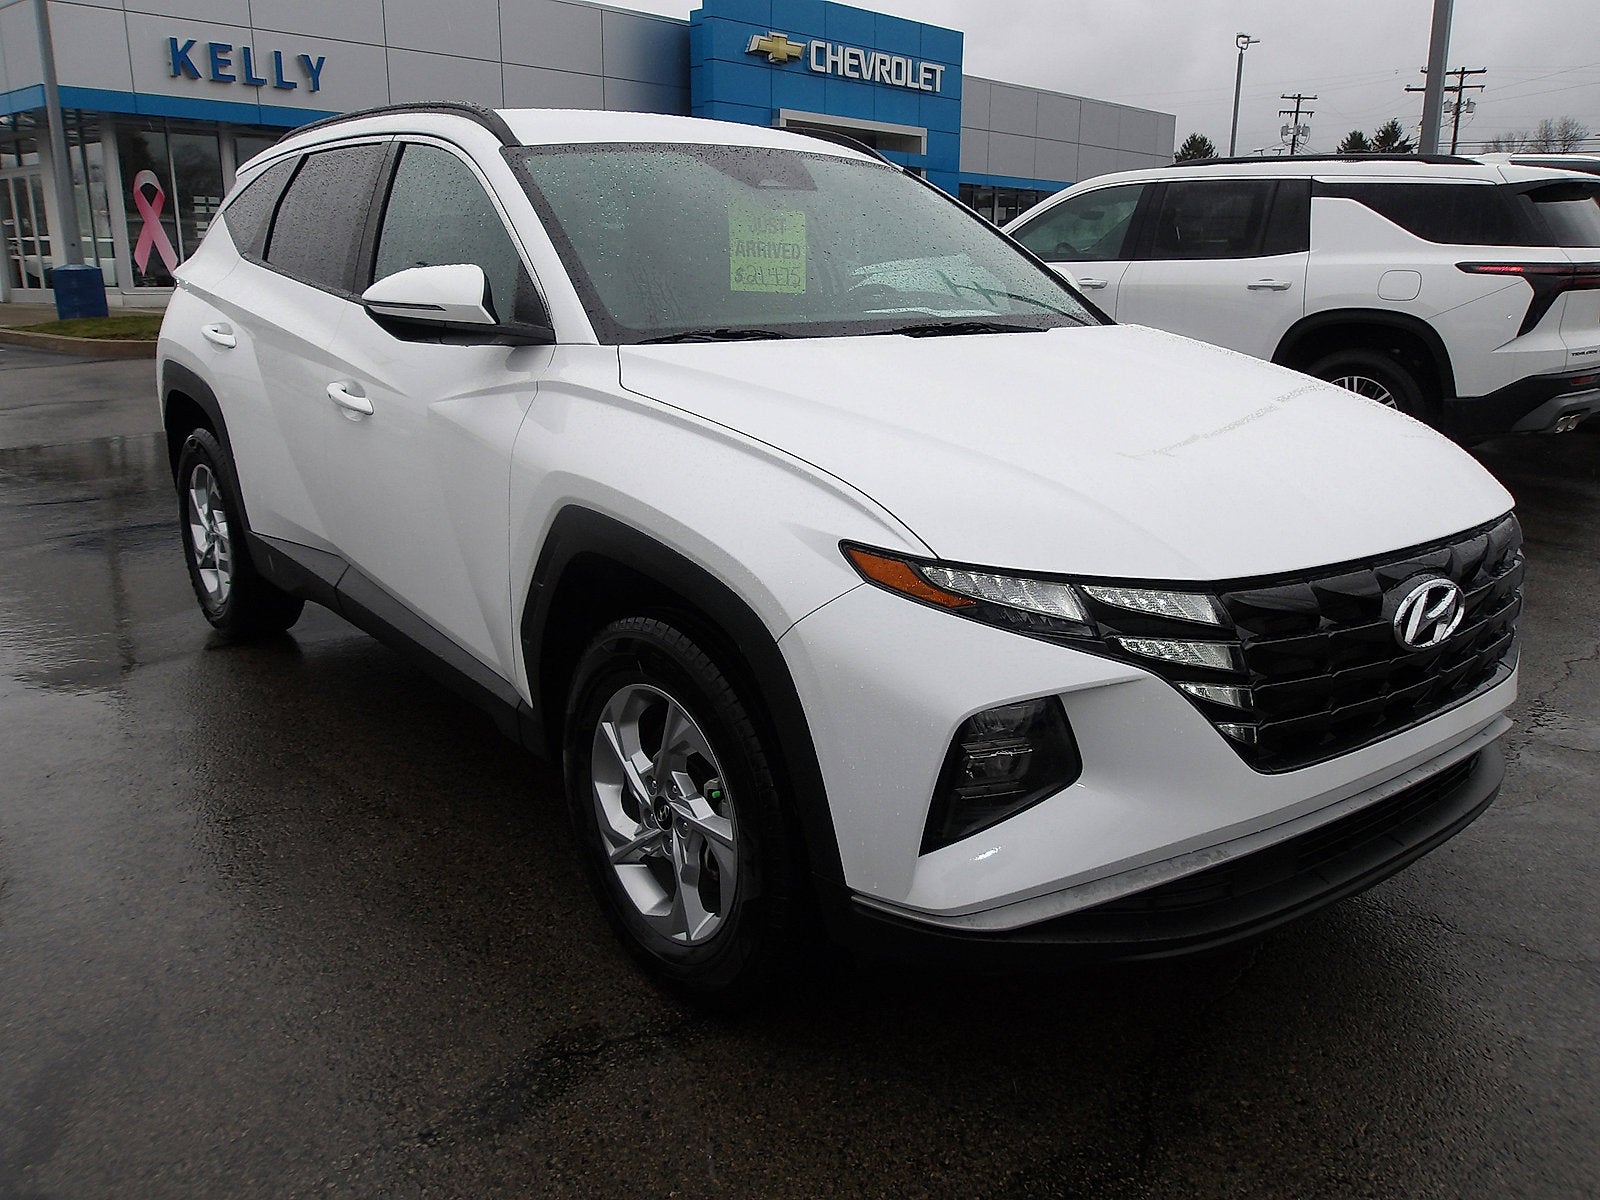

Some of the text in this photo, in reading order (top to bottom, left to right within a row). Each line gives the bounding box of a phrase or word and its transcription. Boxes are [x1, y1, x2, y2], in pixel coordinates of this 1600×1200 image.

[168, 36, 326, 93] KELLY
[808, 39, 945, 92] CHEVROLET
[735, 240, 801, 259] ARRIVED
